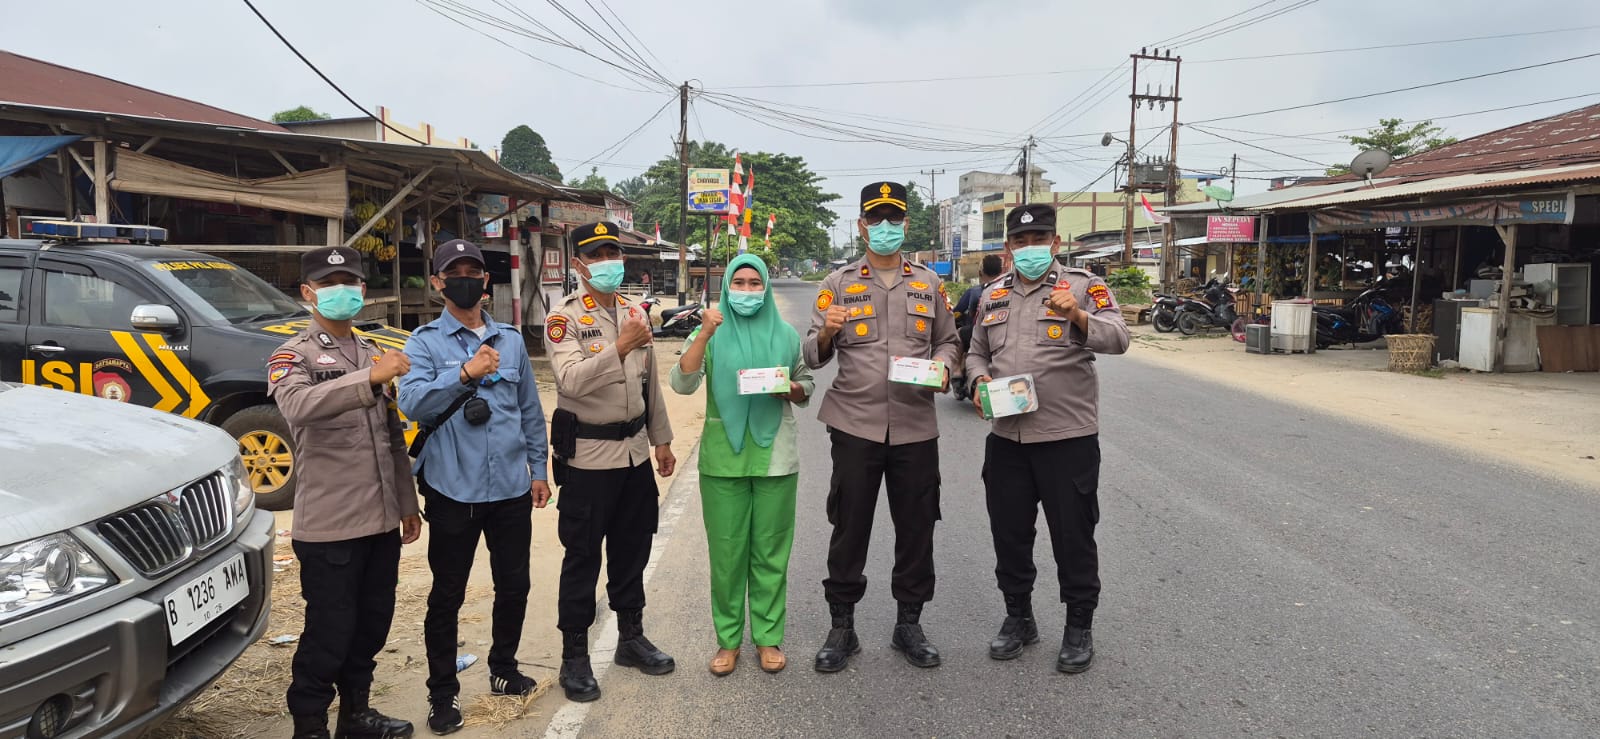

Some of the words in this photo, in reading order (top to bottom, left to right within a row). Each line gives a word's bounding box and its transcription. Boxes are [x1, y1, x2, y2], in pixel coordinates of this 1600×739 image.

[843, 294, 871, 304] RINALDY
[907, 292, 933, 301] POLRI
[167, 599, 178, 626] B
[187, 576, 215, 611] 1236
[223, 559, 245, 590] AMA
